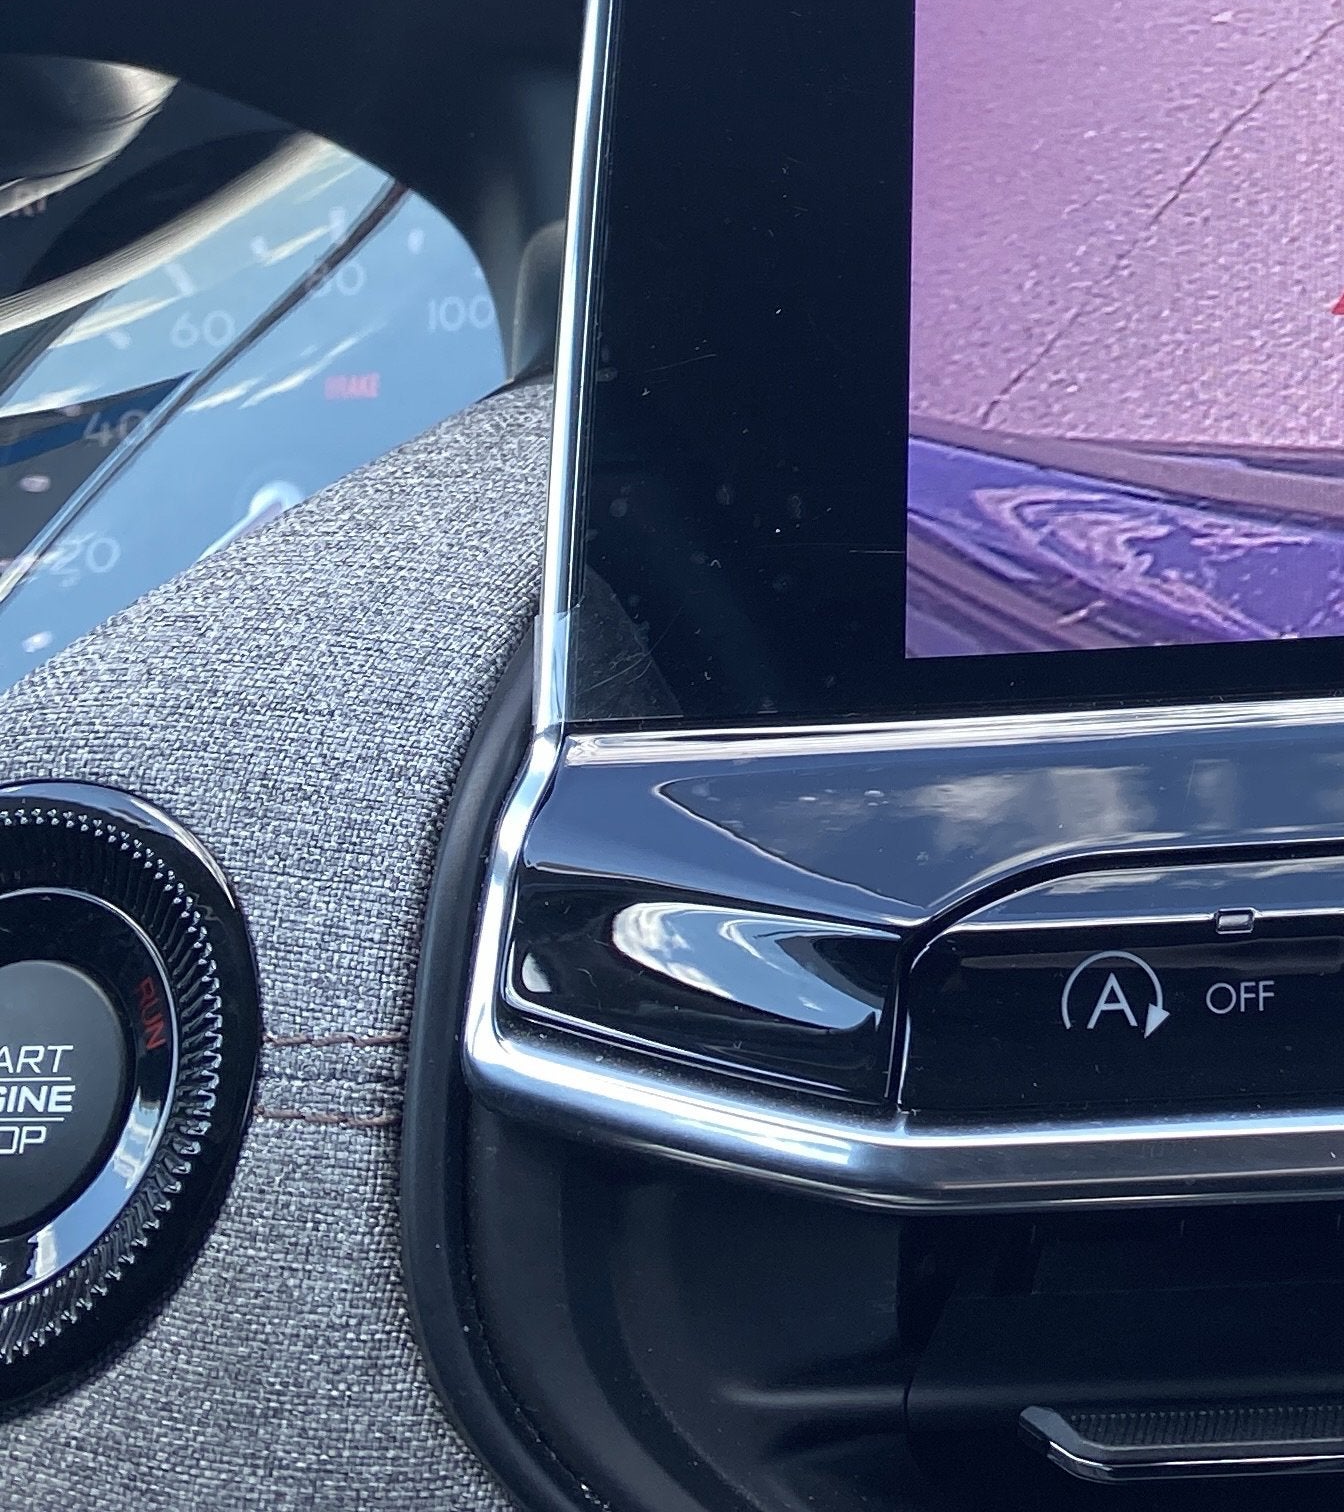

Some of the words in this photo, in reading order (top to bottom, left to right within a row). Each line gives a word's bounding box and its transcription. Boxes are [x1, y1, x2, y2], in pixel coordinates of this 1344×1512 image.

[170, 308, 236, 349] 60
[427, 293, 497, 333] 100
[138, 976, 167, 1051] RUN
[1086, 971, 1139, 1030] A
[1205, 980, 1275, 1015] OFF
[0, 1085, 76, 1113] INE
